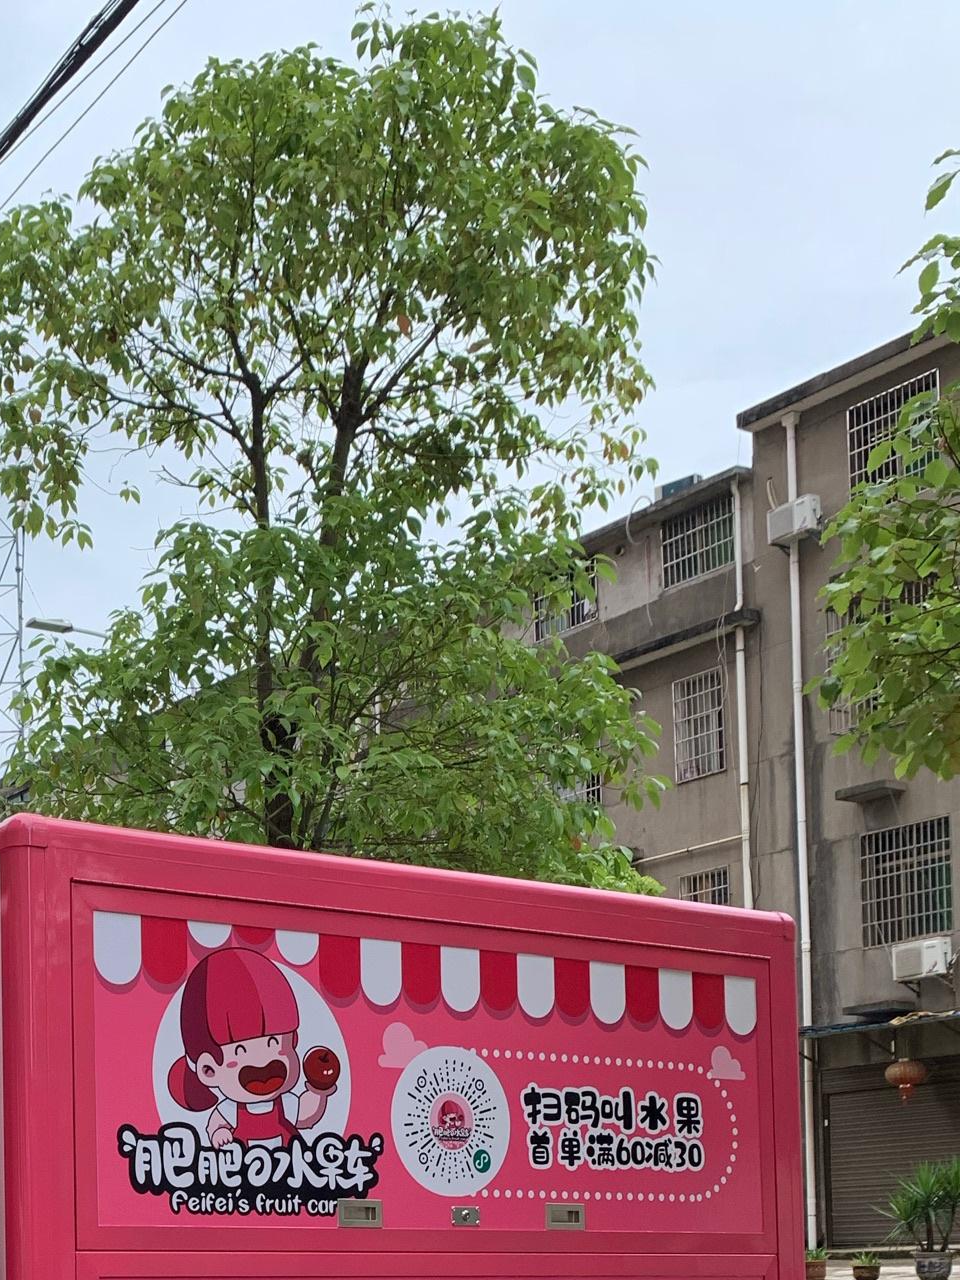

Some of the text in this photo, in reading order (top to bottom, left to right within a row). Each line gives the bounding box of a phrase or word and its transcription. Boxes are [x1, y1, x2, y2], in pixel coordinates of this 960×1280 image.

[524, 1086, 703, 1135] 扫码叫水果
[529, 1131, 704, 1168] 首单满60减30
[171, 1190, 338, 1214] Feifei's fruit car
